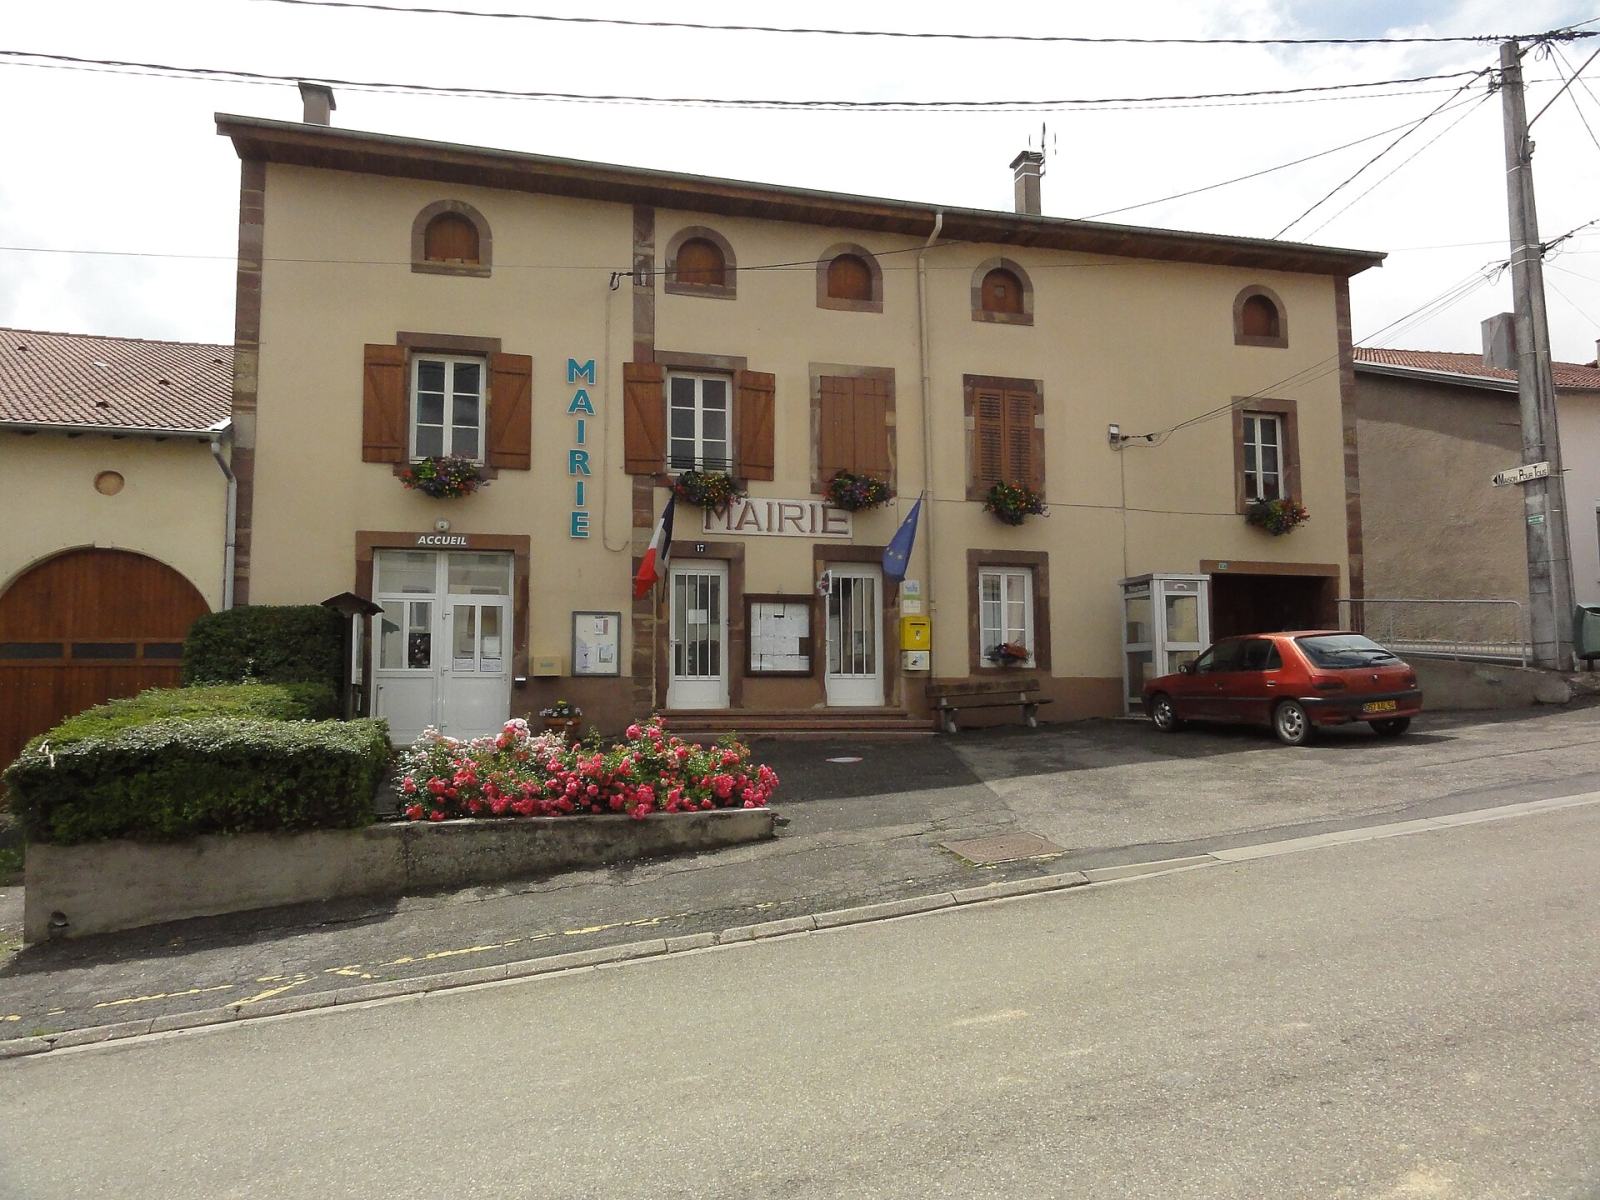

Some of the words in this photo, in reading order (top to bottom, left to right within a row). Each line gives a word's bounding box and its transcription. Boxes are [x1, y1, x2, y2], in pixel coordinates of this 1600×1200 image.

[567, 357, 596, 539] MAIRIE
[704, 500, 849, 535] MAIRIE
[417, 535, 467, 545] ACCUEIL
[695, 544, 705, 552] 17
